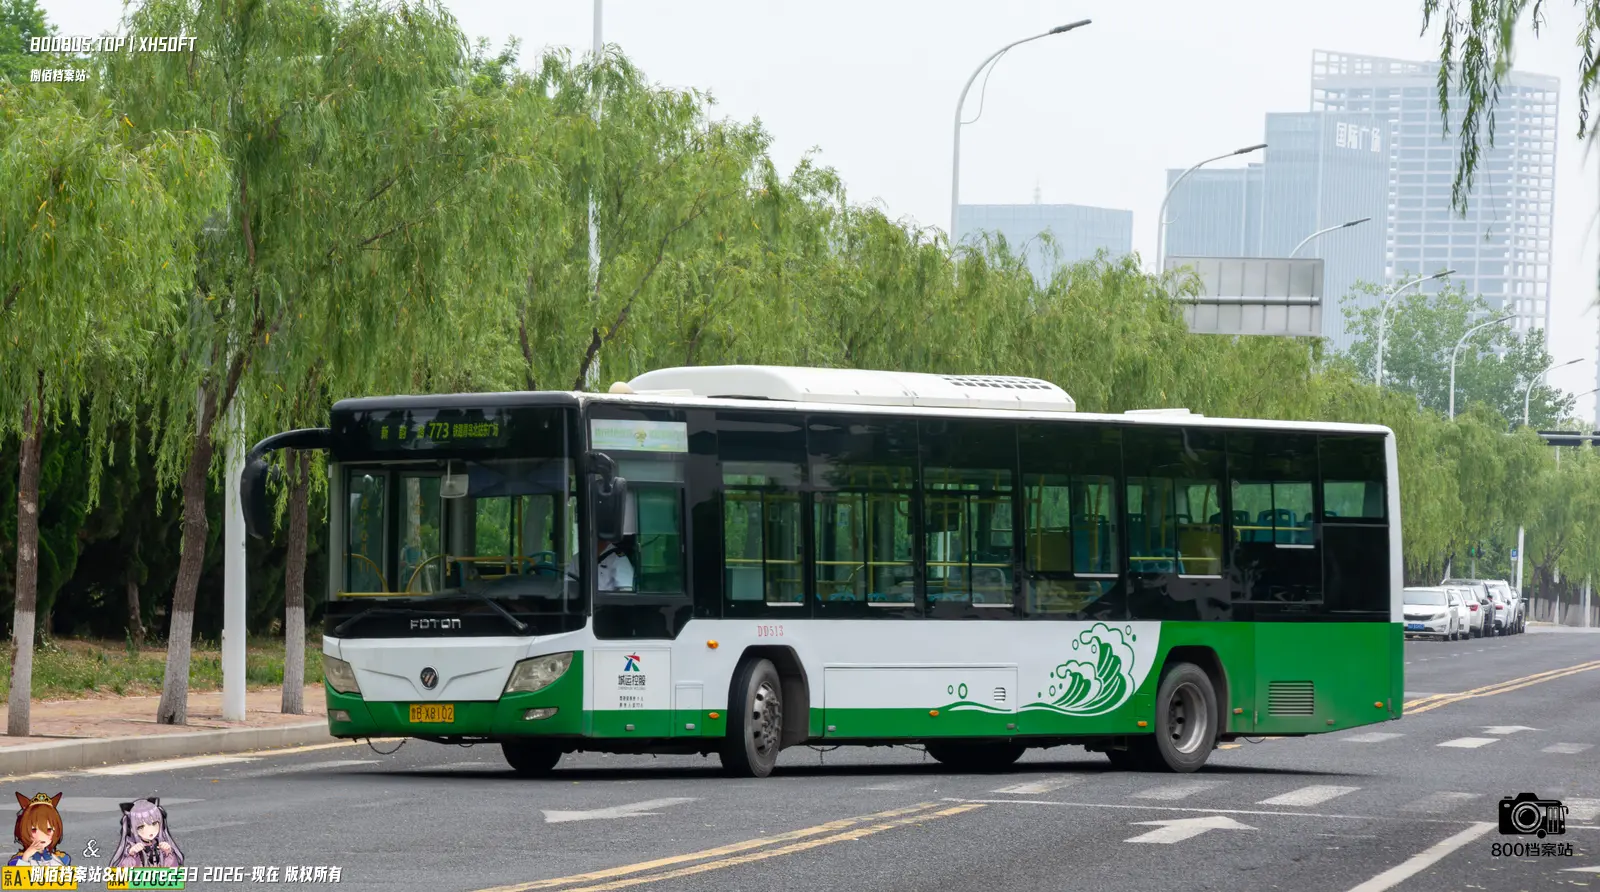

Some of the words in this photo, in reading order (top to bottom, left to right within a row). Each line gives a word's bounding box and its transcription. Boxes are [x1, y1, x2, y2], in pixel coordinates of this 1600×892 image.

[1336, 121, 1380, 152] 国际广场
[428, 422, 449, 439] 773
[410, 618, 462, 630] FOTON
[757, 624, 784, 637] DD513
[617, 674, 646, 686] 城运控股
